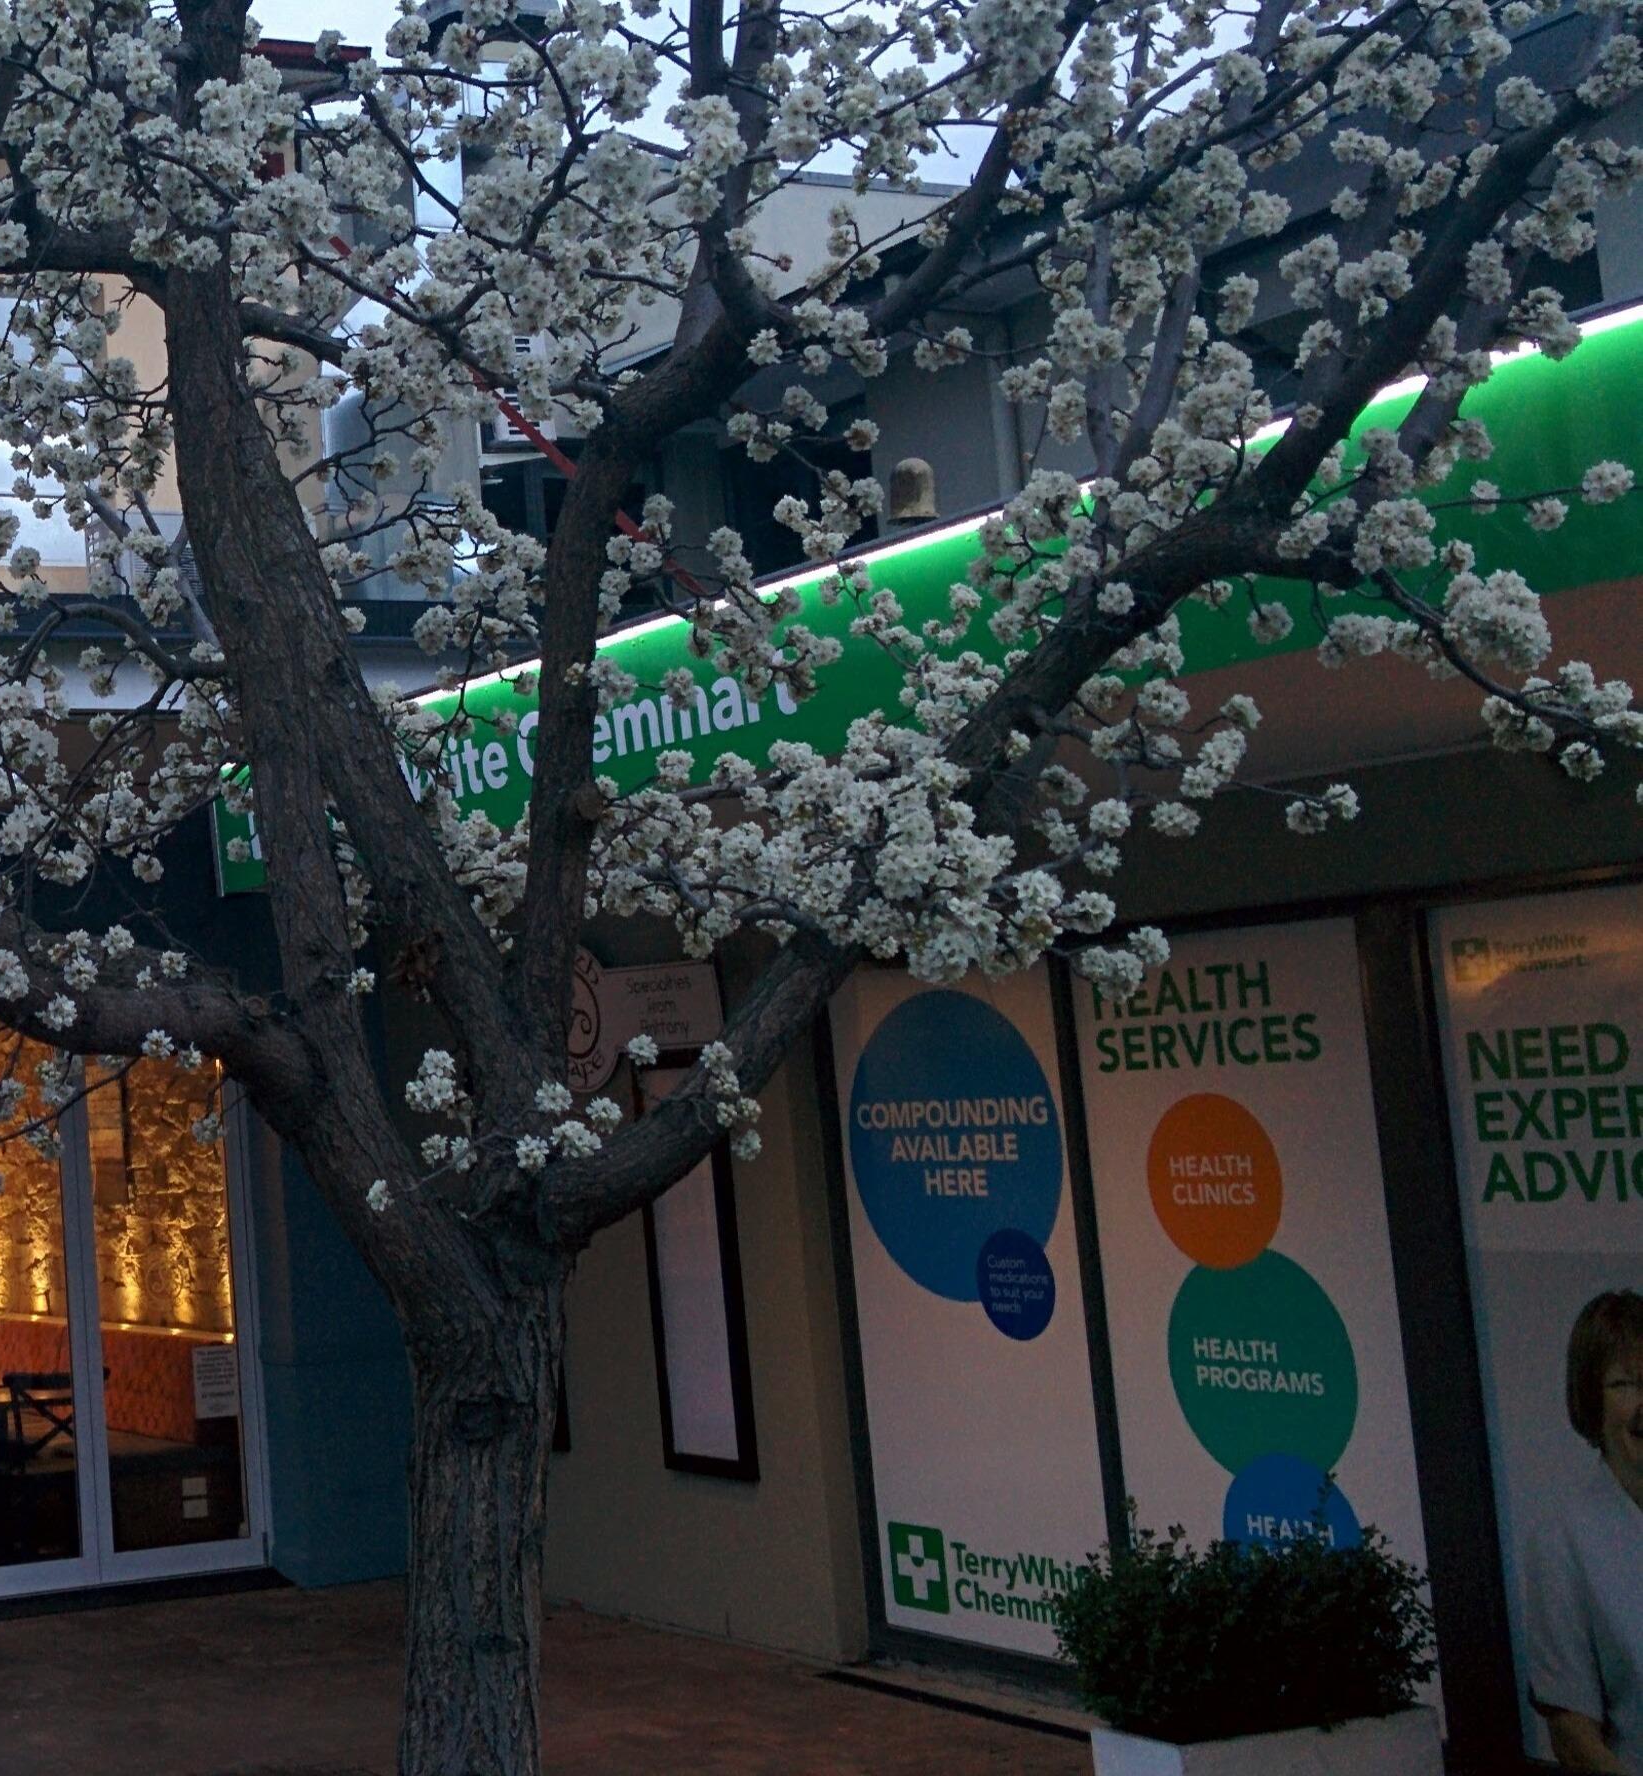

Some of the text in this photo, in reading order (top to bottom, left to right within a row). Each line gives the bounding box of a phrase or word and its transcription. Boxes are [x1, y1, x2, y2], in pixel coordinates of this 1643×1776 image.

[517, 650, 798, 777] Cemmart
[1096, 1013, 1321, 1073] SERVICES
[1466, 1022, 1630, 1081] NEED
[857, 1095, 1048, 1130] COMPOUNDING
[890, 1132, 1018, 1163] AVAILABLE
[1168, 1154, 1253, 1177] HEALTH
[924, 1168, 989, 1197] HERE
[1171, 1182, 1256, 1206] CLINICS
[1193, 1336, 1278, 1363] HEALTH
[1195, 1365, 1325, 1397] PROGRAMS
